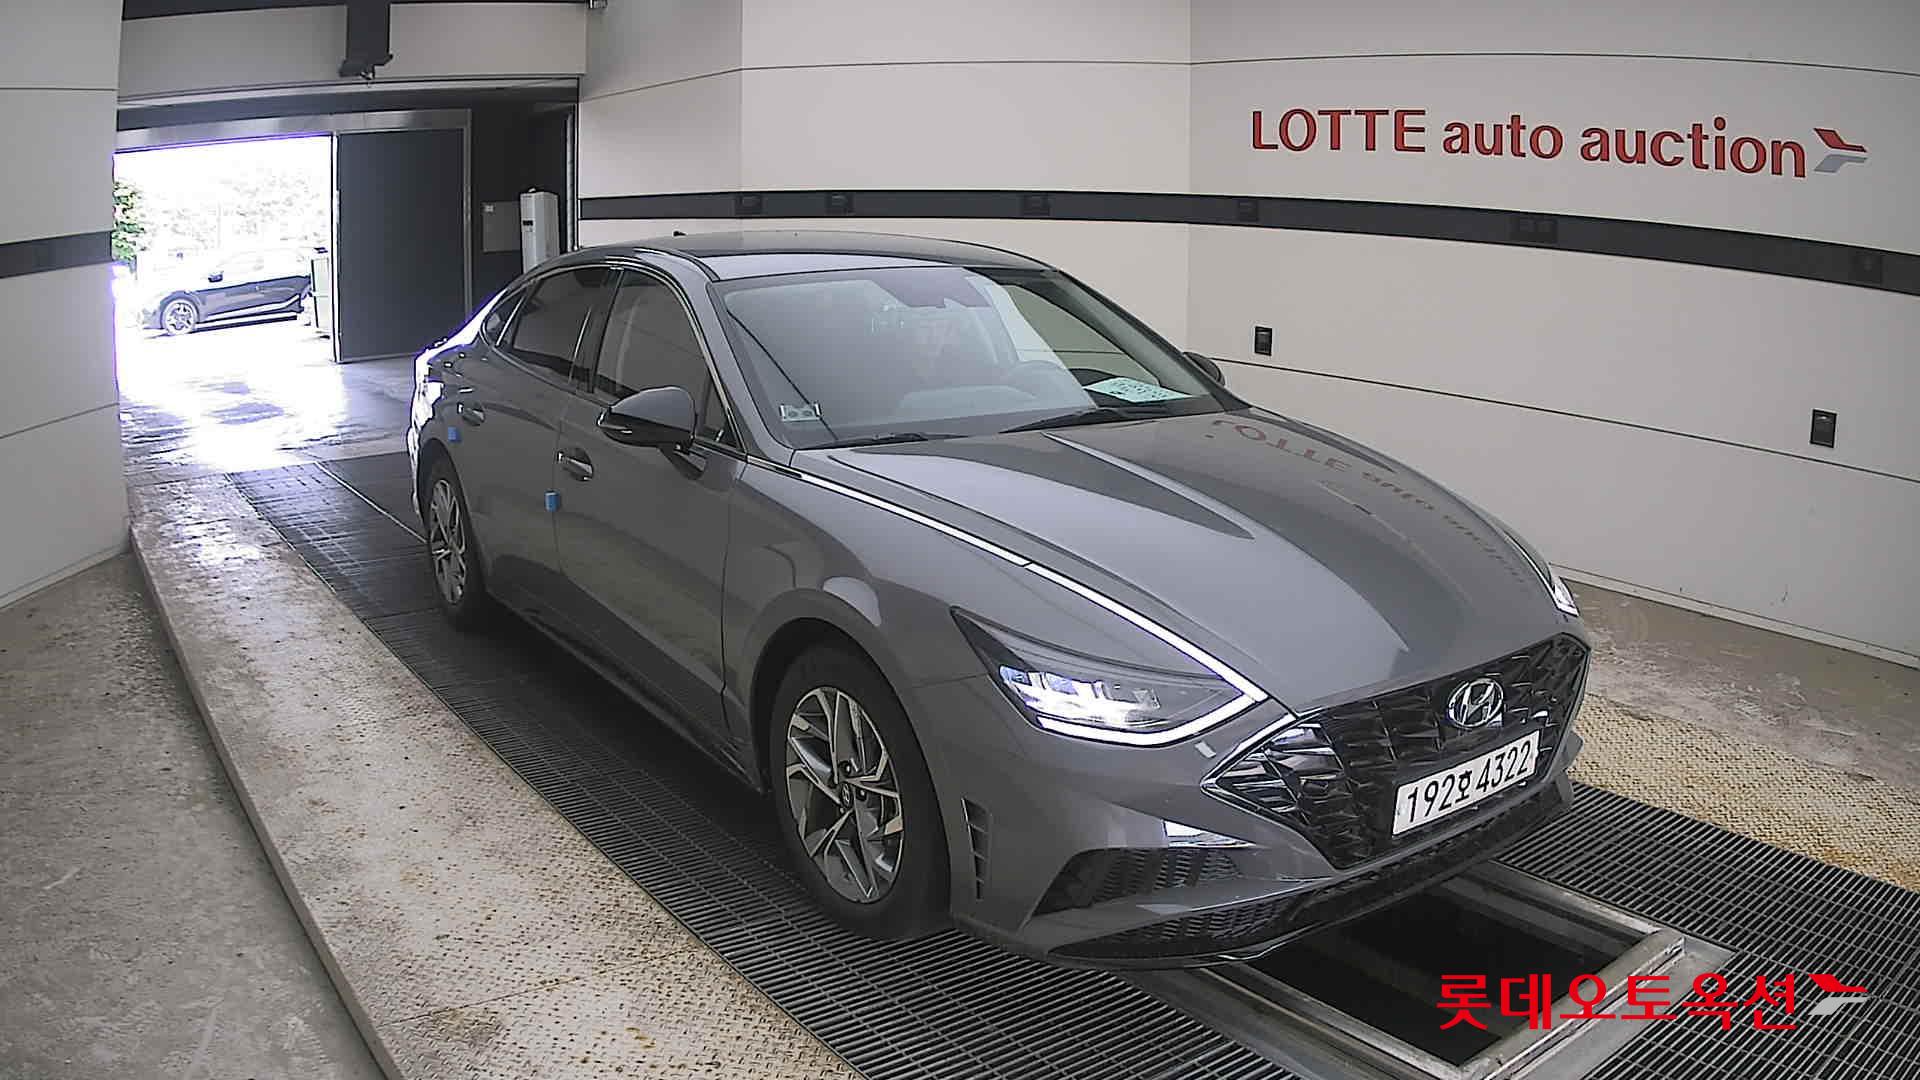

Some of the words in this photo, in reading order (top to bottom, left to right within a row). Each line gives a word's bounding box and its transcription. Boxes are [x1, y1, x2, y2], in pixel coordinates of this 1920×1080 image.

[1251, 108, 1426, 153] LOTTE
[1442, 114, 1564, 160] auto
[1579, 115, 1806, 178] auction
